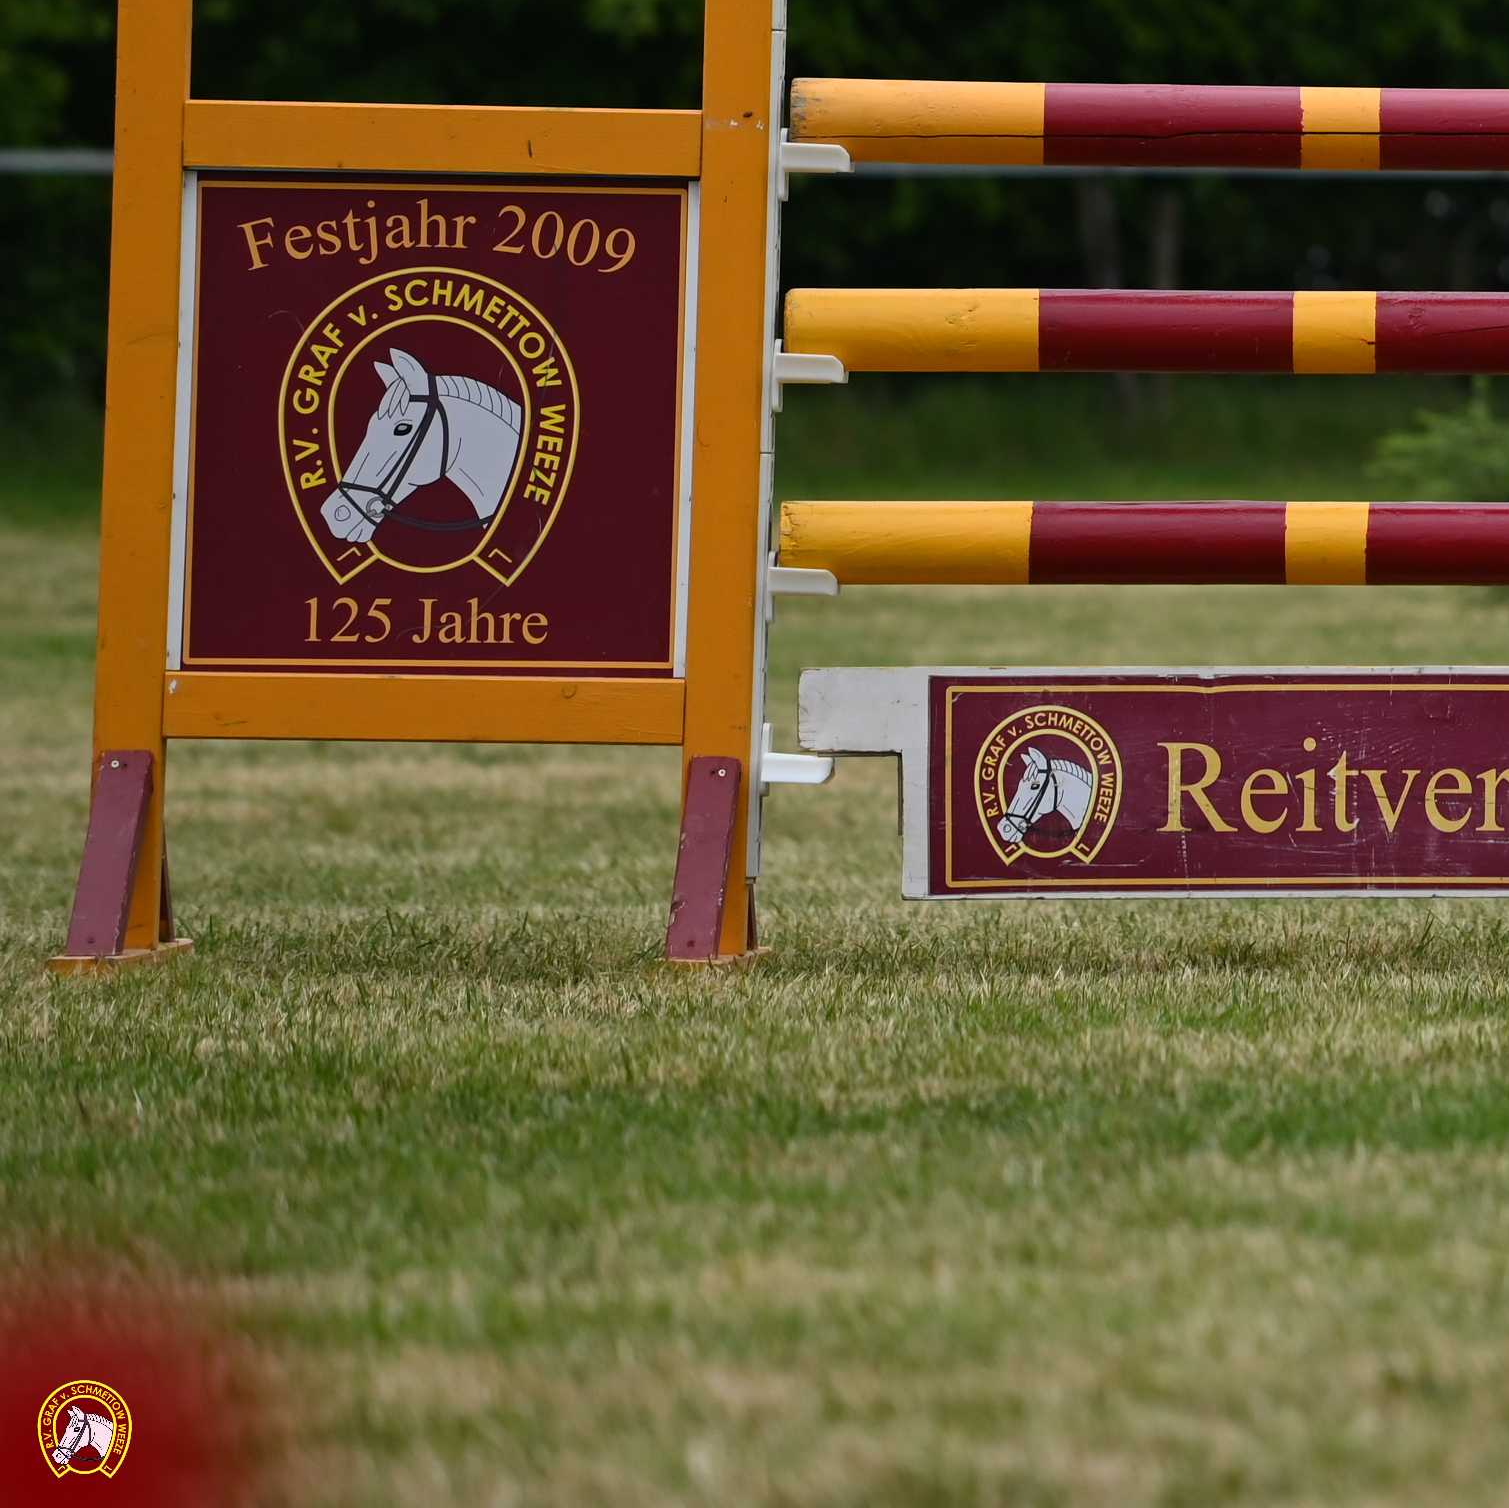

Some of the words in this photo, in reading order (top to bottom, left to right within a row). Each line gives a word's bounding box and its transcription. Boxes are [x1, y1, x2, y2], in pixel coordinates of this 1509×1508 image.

[238, 199, 476, 271] Festjahr
[492, 205, 636, 272] 2009
[293, 322, 343, 414] GRAF
[347, 308, 378, 327] v.
[384, 279, 562, 388] SCHMETTOW
[523, 403, 566, 506] WEEZE
[303, 597, 392, 643] 125
[412, 597, 549, 644] Jahre
[982, 735, 1006, 780] GRAF
[1008, 726, 1022, 738] v.
[1025, 713, 1113, 765] SCHMETTOW
[1094, 773, 1114, 822] WEEZE
